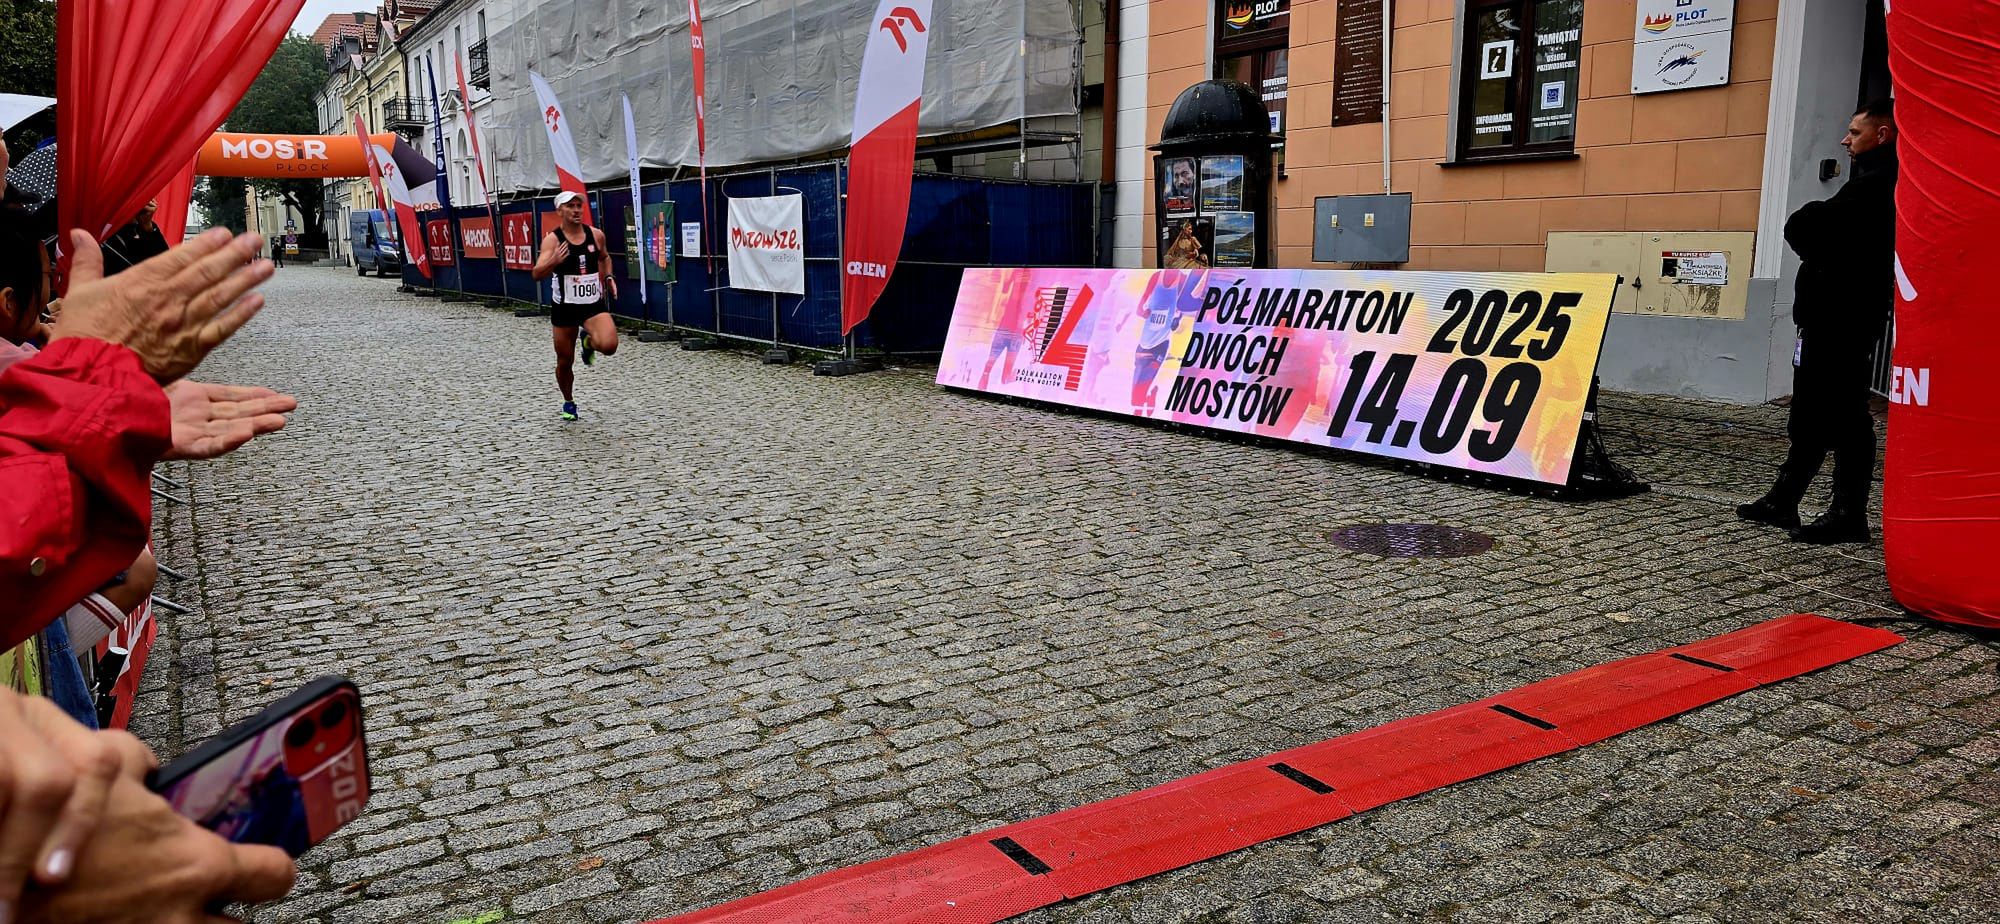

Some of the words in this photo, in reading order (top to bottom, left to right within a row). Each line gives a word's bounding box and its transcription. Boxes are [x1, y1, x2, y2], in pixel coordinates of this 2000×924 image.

[1255, 0, 1279, 16] PLOT
[1676, 9, 1707, 21] PLOT
[1538, 29, 1579, 46] PAMIĄTKI
[221, 138, 329, 160] MOSiR
[276, 163, 329, 172] PŁOCK
[846, 261, 887, 279] ORLEN
[572, 283, 597, 298] 1090
[1195, 279, 1415, 336] PÓŁMARATON
[1425, 288, 1583, 362] 2025
[1182, 325, 1289, 376] DWÓCH
[1016, 368, 1063, 381] PÓŁMARATON
[1164, 375, 1294, 427] MOSTÓW
[1326, 350, 1543, 464] 14.09
